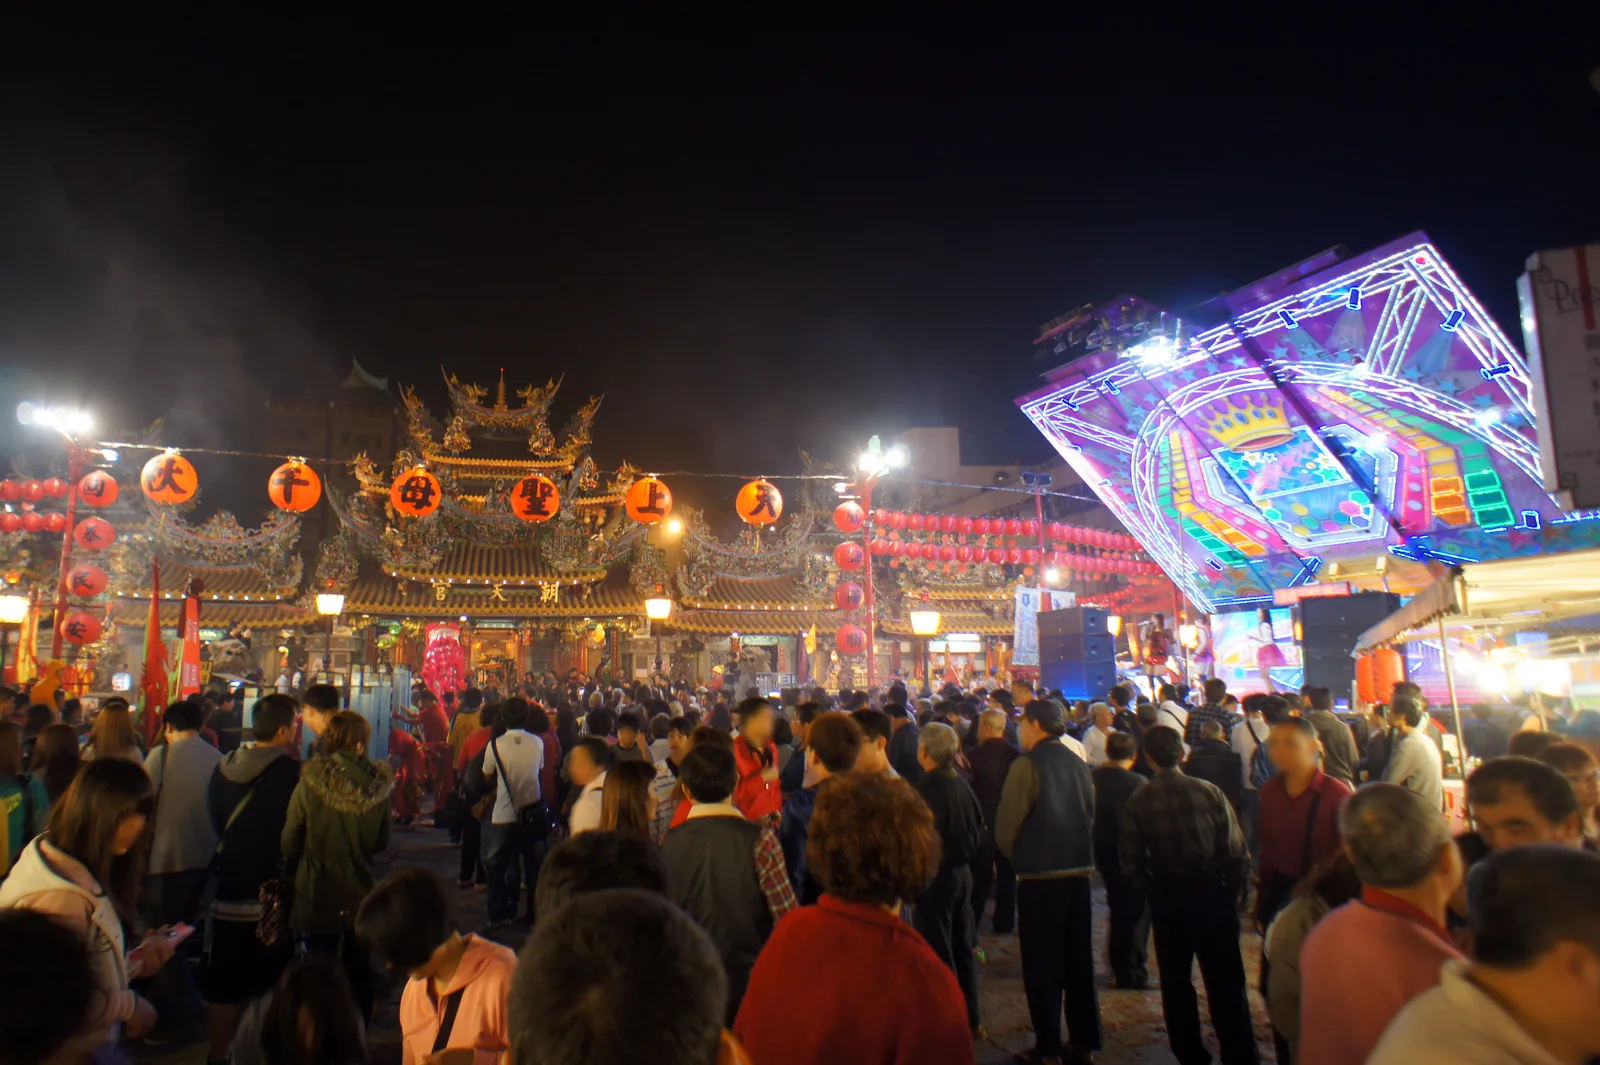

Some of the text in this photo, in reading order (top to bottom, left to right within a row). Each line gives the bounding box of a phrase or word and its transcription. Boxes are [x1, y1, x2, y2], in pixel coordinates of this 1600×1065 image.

[272, 467, 310, 505] 千
[397, 476, 436, 510] 母
[518, 478, 554, 516] 聖
[636, 482, 665, 516] 上
[749, 484, 777, 518] 天
[82, 525, 102, 543] 泰
[73, 571, 93, 589] 民
[65, 620, 87, 639] 安
